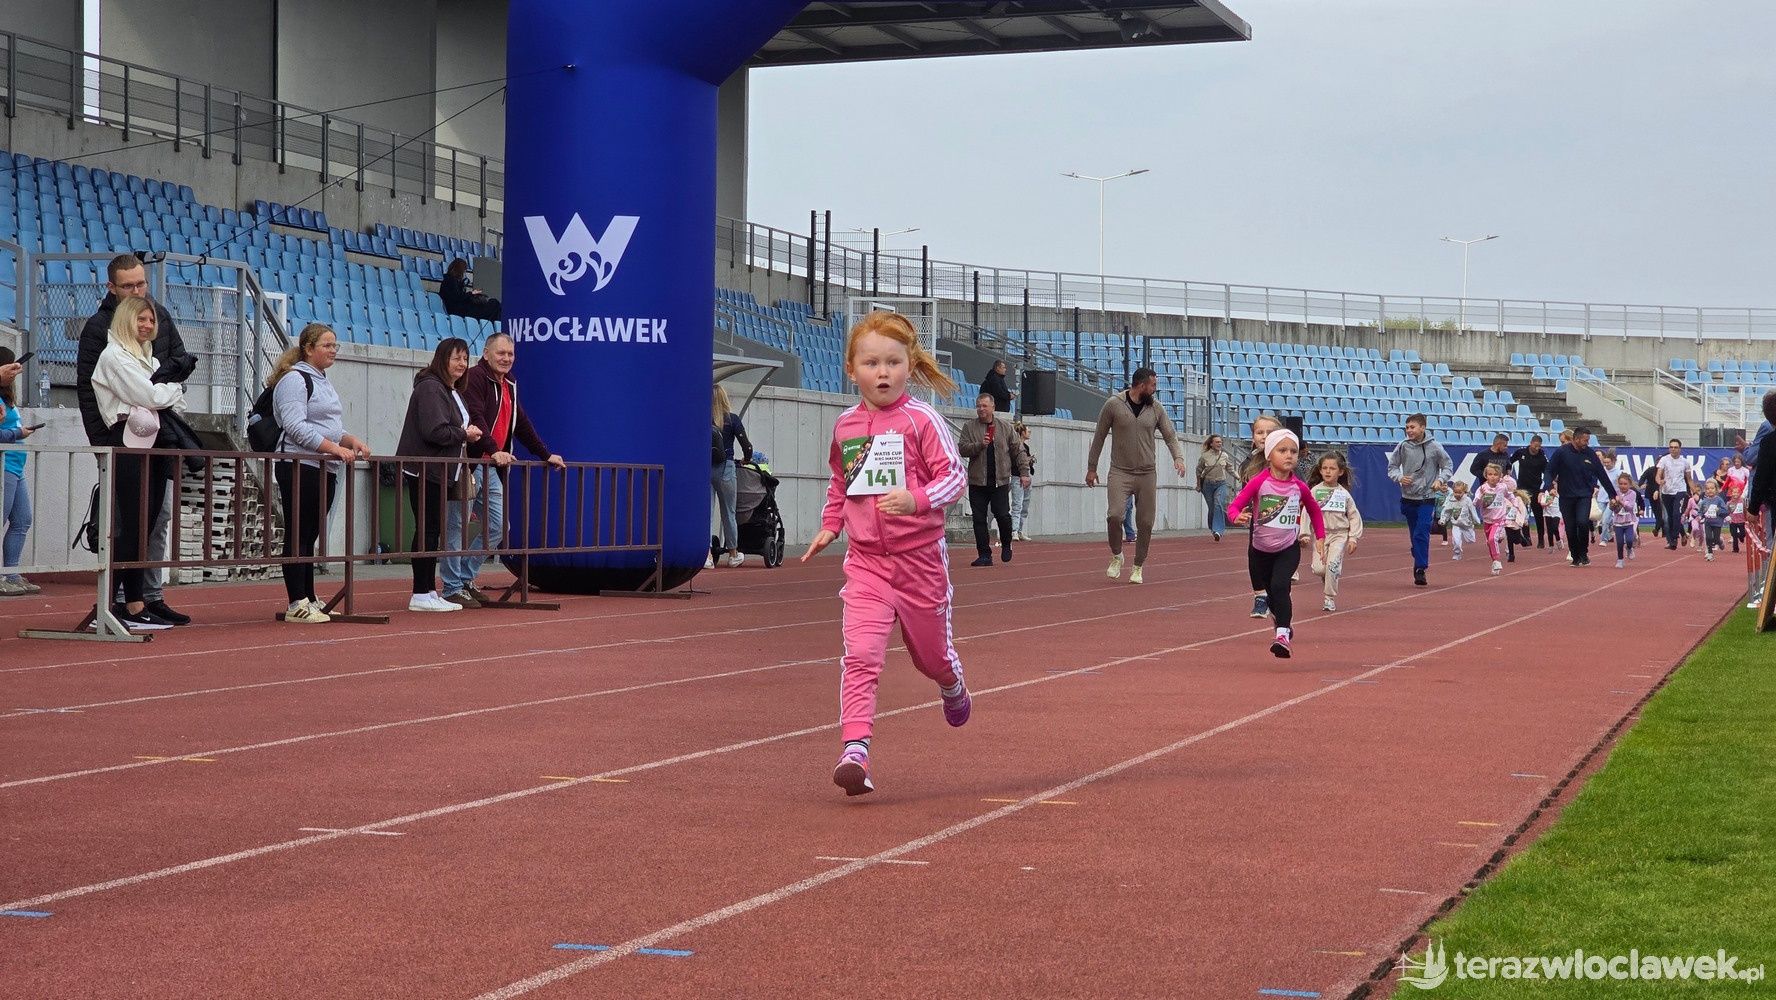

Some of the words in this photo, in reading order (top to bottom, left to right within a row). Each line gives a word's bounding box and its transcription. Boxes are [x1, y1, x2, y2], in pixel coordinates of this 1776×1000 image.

[508, 316, 667, 344] WŁOCŁAWEK
[865, 469, 897, 487] 141
[1329, 501, 1345, 509] 235
[1279, 515, 1296, 525] 019
